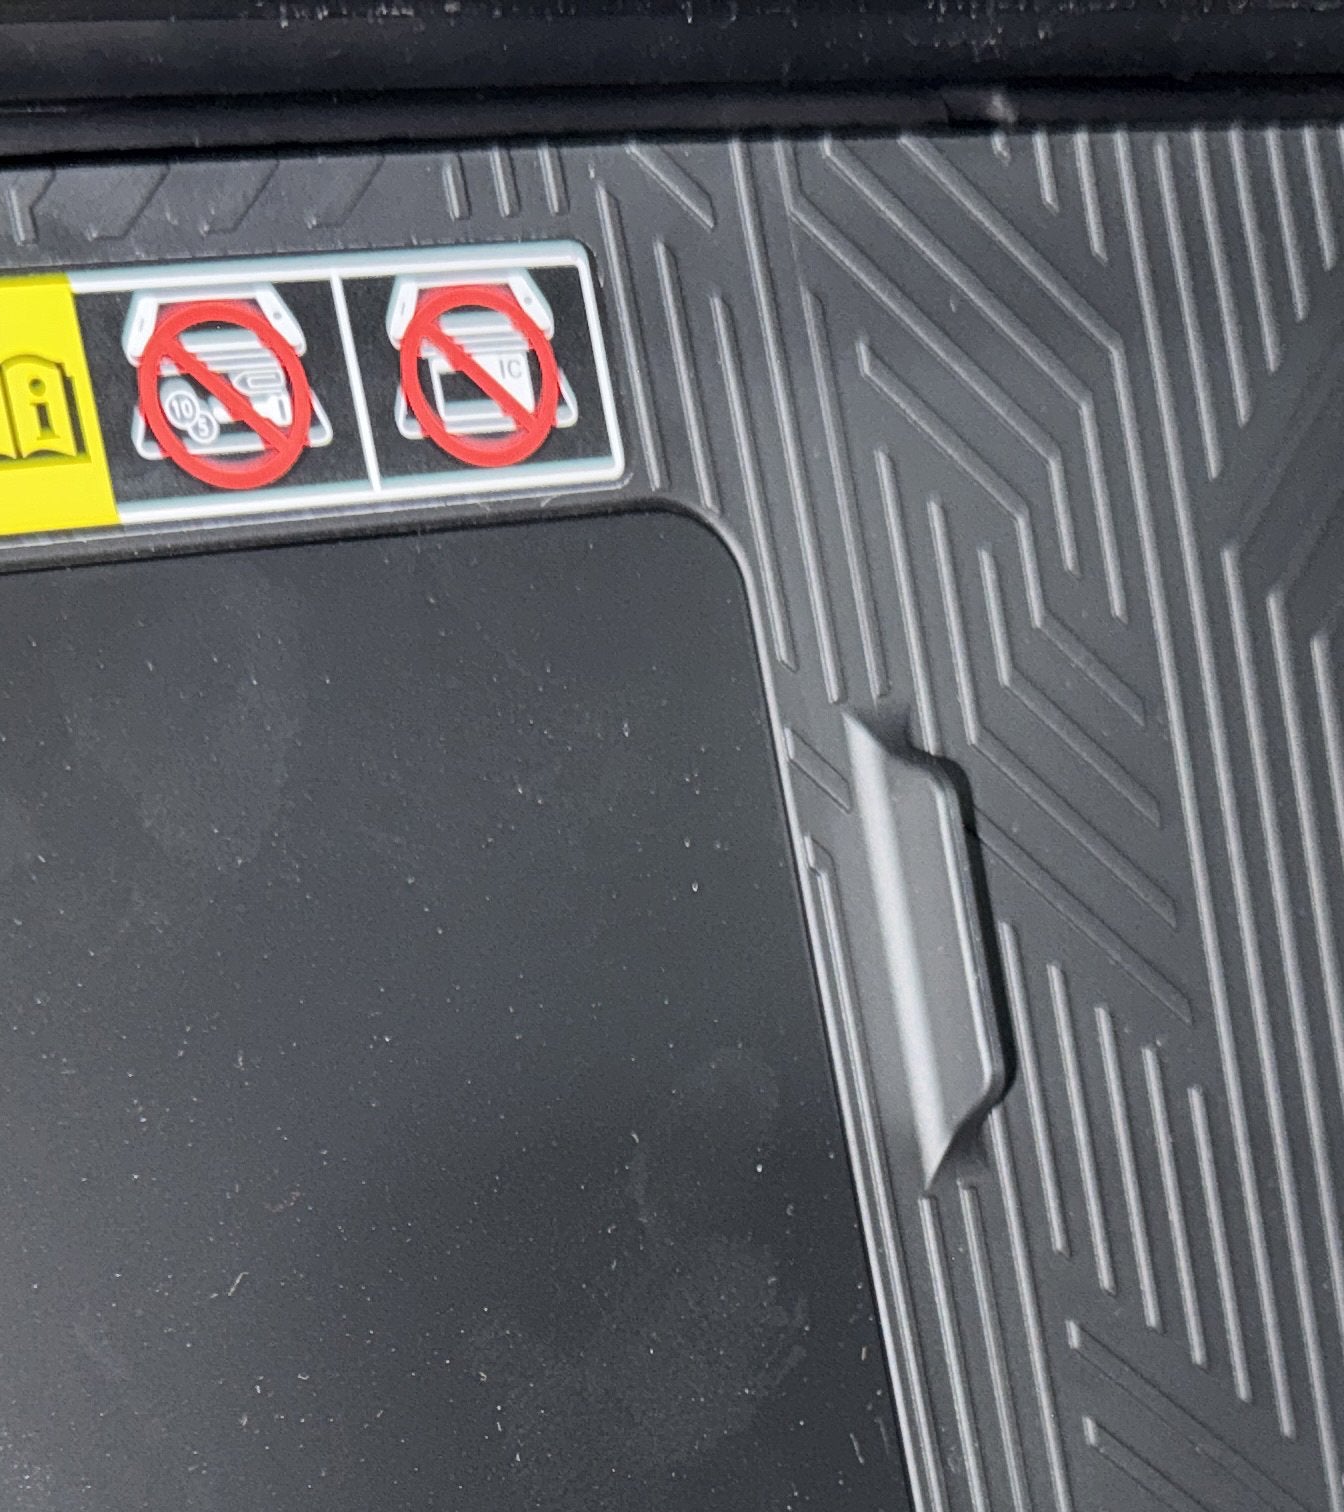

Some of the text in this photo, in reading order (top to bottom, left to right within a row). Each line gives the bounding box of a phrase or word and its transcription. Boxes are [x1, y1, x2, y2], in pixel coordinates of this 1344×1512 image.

[498, 358, 523, 379] IC
[170, 398, 194, 421] 10
[196, 417, 210, 434] 5
